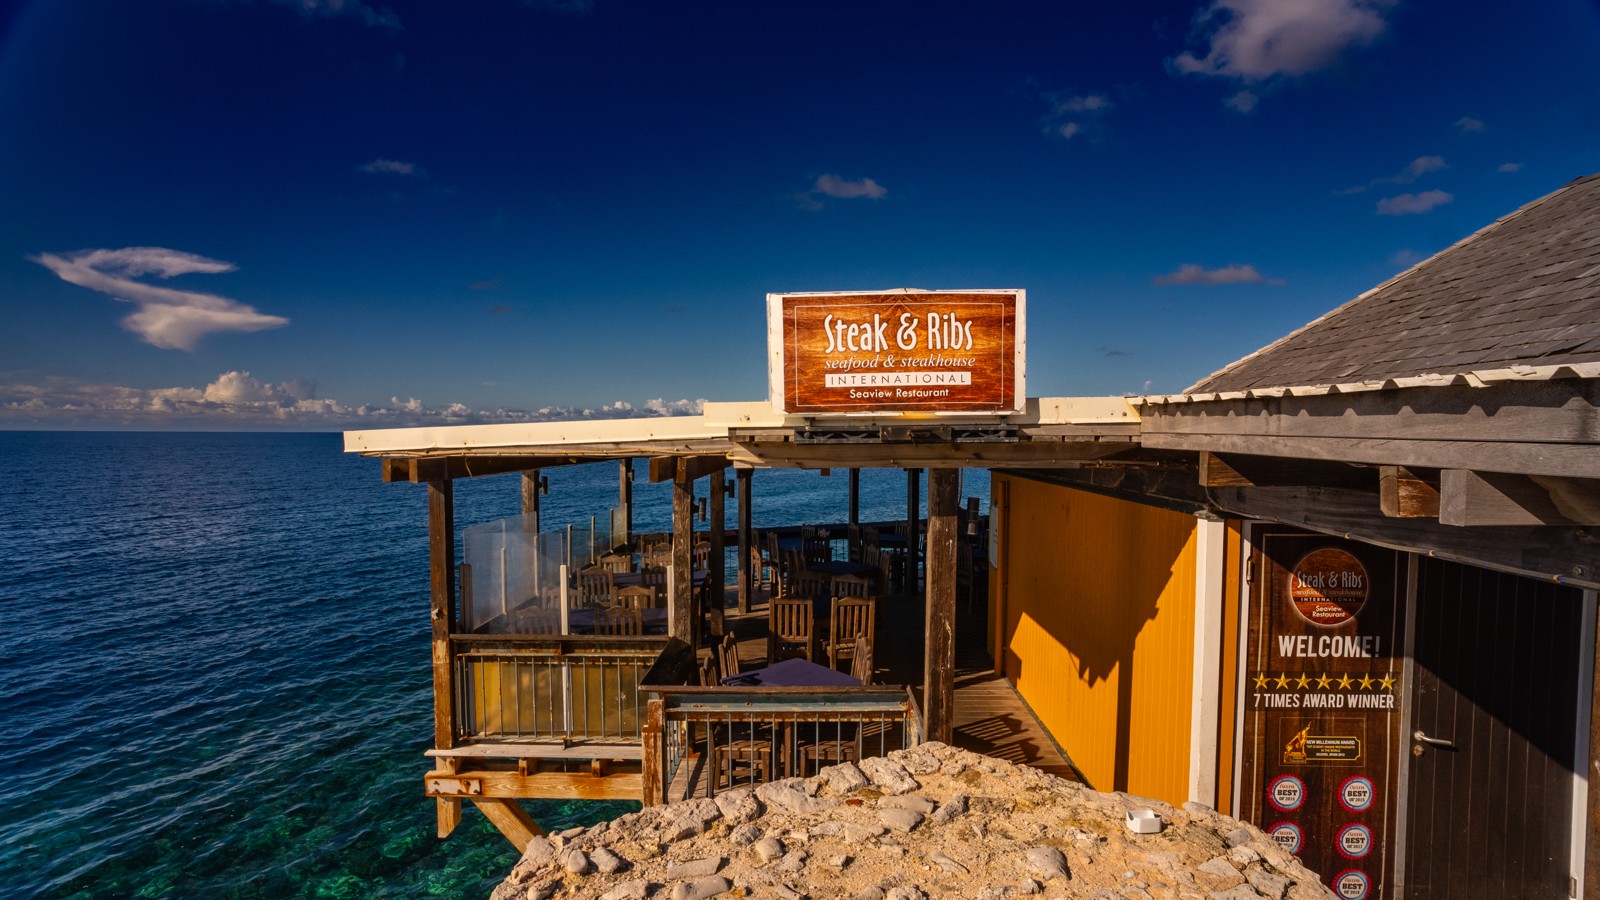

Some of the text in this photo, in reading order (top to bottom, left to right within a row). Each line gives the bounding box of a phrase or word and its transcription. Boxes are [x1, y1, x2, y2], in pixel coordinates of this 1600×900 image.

[824, 312, 973, 354] Steak & Ribs
[824, 351, 976, 372] seafood & steakhouse
[830, 373, 966, 385] INTERNATIONAL
[850, 388, 949, 399] Seaview Restaurant
[1297, 571, 1362, 588] Steak & Ribs
[1278, 635, 1381, 658] WELCOME!
[1253, 693, 1395, 709] 7 TIMES AWARD WINNER
